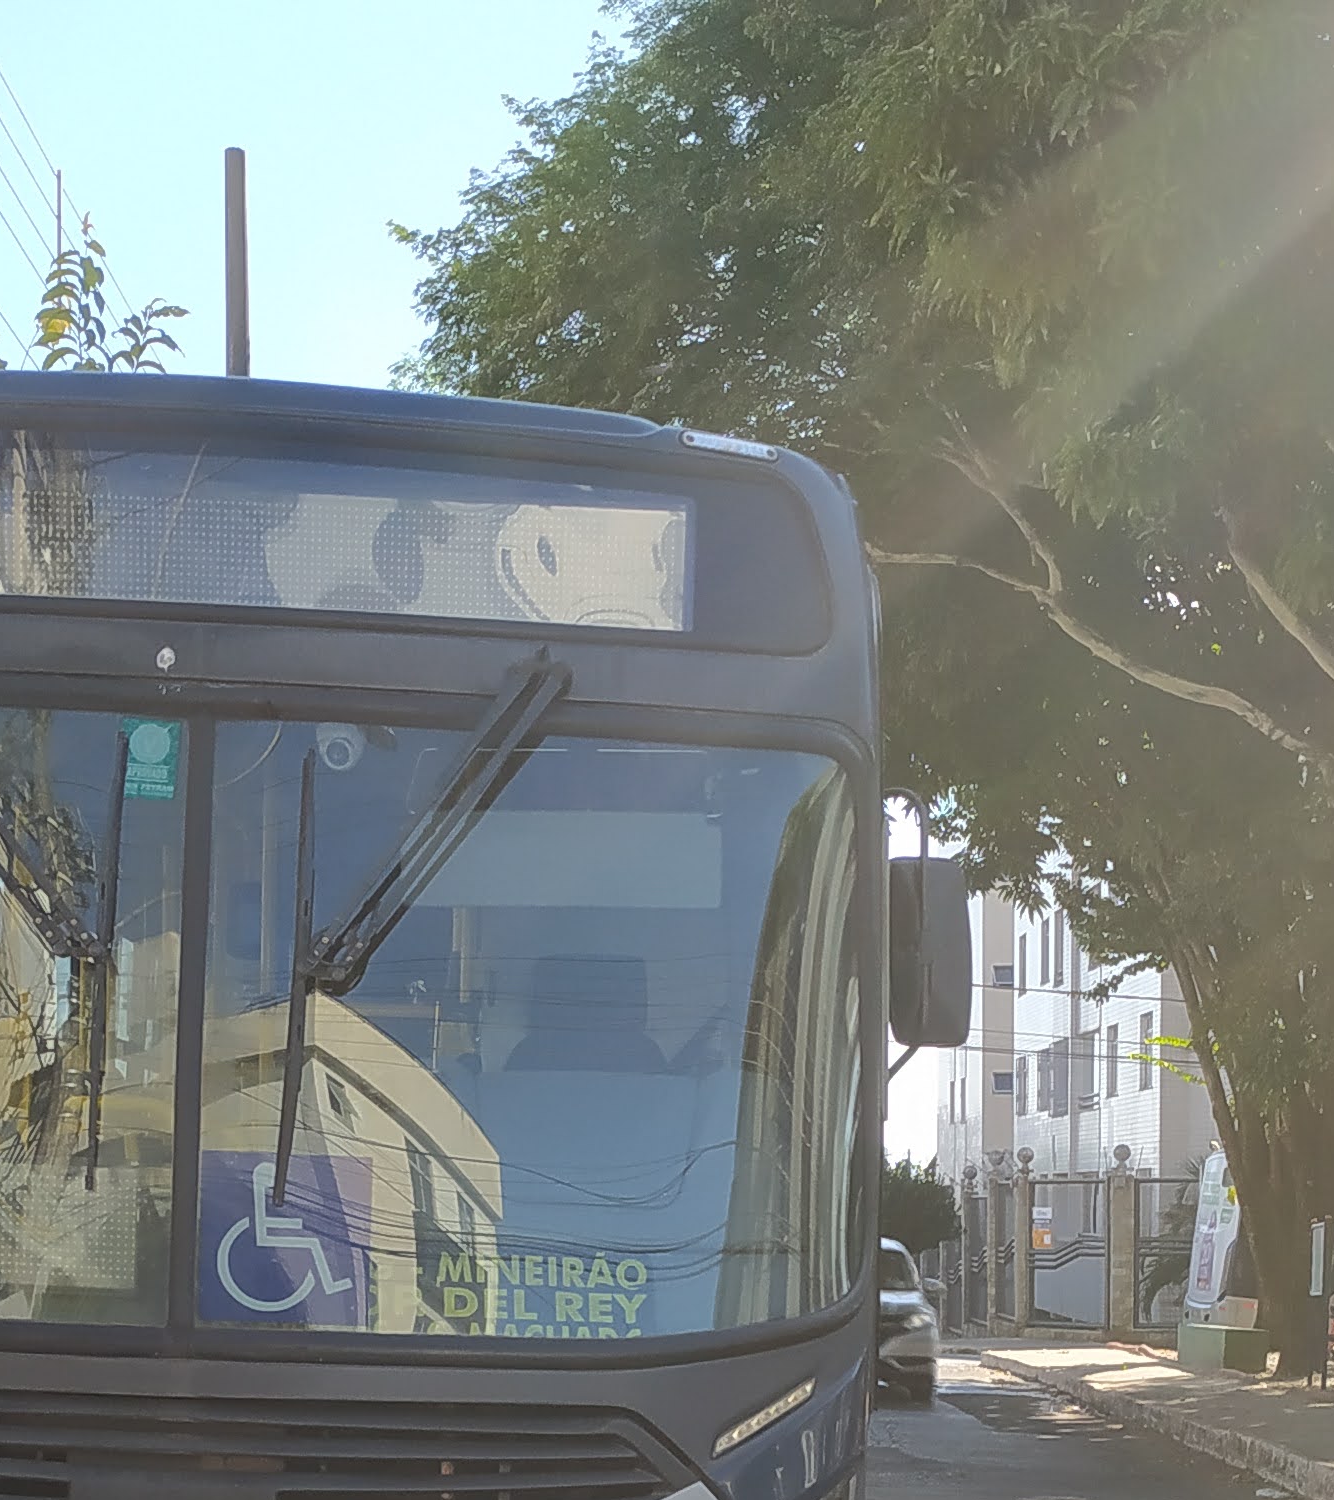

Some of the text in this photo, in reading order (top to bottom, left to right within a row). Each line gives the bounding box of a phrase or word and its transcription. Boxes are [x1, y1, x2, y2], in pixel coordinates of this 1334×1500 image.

[435, 1252, 648, 1291] MINEIRÃO
[443, 1287, 648, 1324] DEL REY
